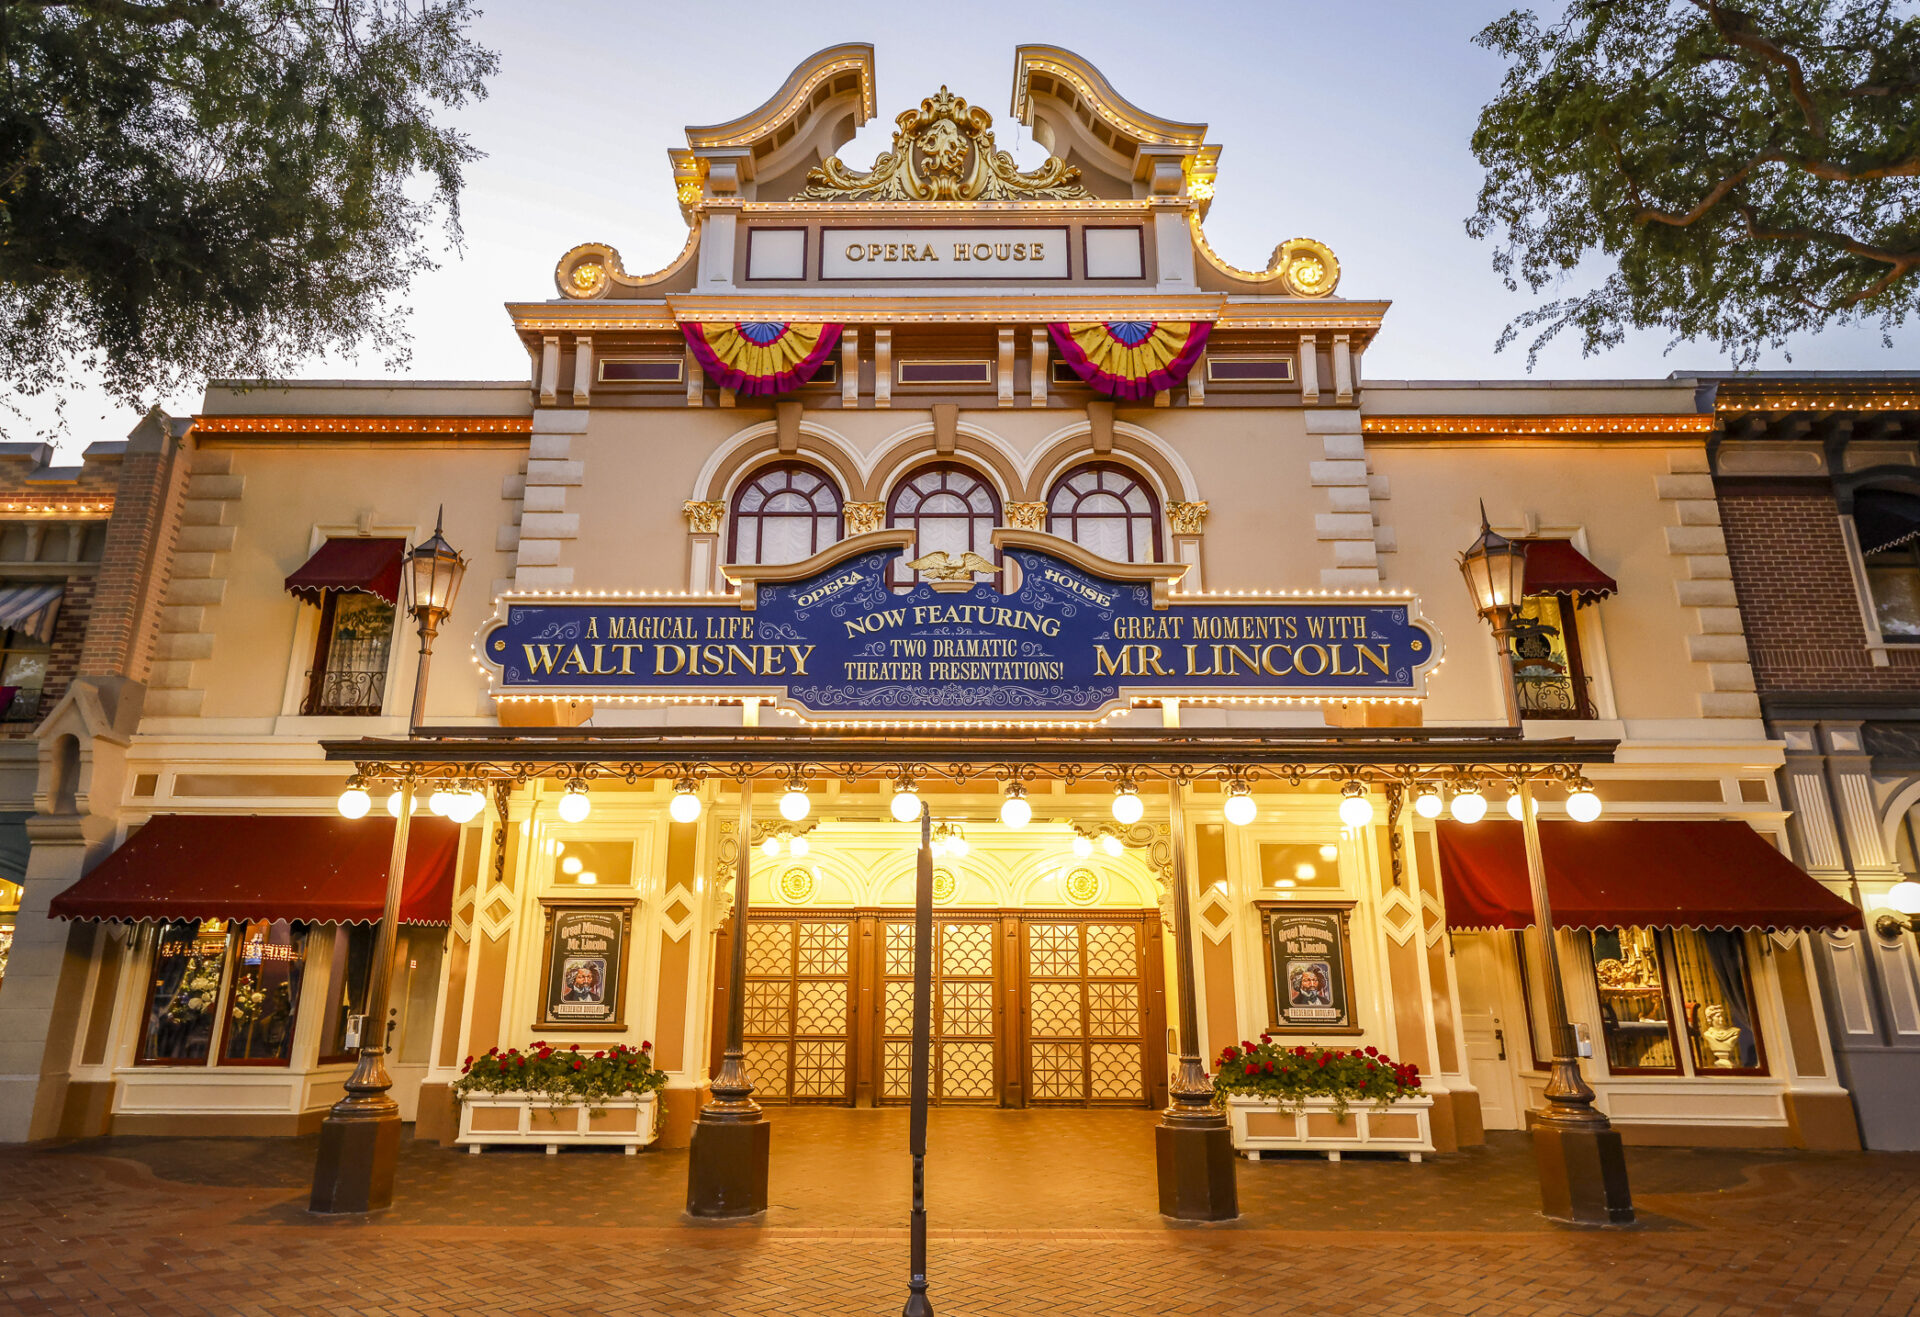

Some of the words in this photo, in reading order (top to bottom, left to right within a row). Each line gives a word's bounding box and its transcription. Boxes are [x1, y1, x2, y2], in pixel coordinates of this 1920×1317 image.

[845, 242, 939, 262] OPERA
[953, 242, 1045, 261] HOUSE
[797, 570, 864, 607] OPERA
[1044, 568, 1112, 607] HOUSE
[584, 616, 599, 639] A
[608, 616, 698, 640] MAGICAL
[705, 616, 754, 640] LIFE
[843, 606, 907, 640] NOW
[913, 604, 1061, 638] FEATURING
[1113, 616, 1184, 640] GREAT
[1192, 616, 1298, 640] MOMENTS
[1305, 616, 1367, 640] WITH
[522, 643, 643, 675] WALT
[652, 643, 817, 676] DISNEY
[890, 639, 927, 658] TWO
[934, 639, 1018, 658] DRAMATIC
[844, 661, 922, 681] THEATER
[929, 661, 1064, 681] PRESENTATIONS!
[1092, 644, 1176, 676] MR.
[1182, 643, 1391, 677] LINCOLN
[561, 923, 581, 939] Great
[582, 922, 614, 940] Moments
[1279, 926, 1298, 942] Great
[1298, 924, 1334, 943] Moments
[581, 938, 607, 950] Lincoln
[1300, 941, 1328, 953] Lincoln
